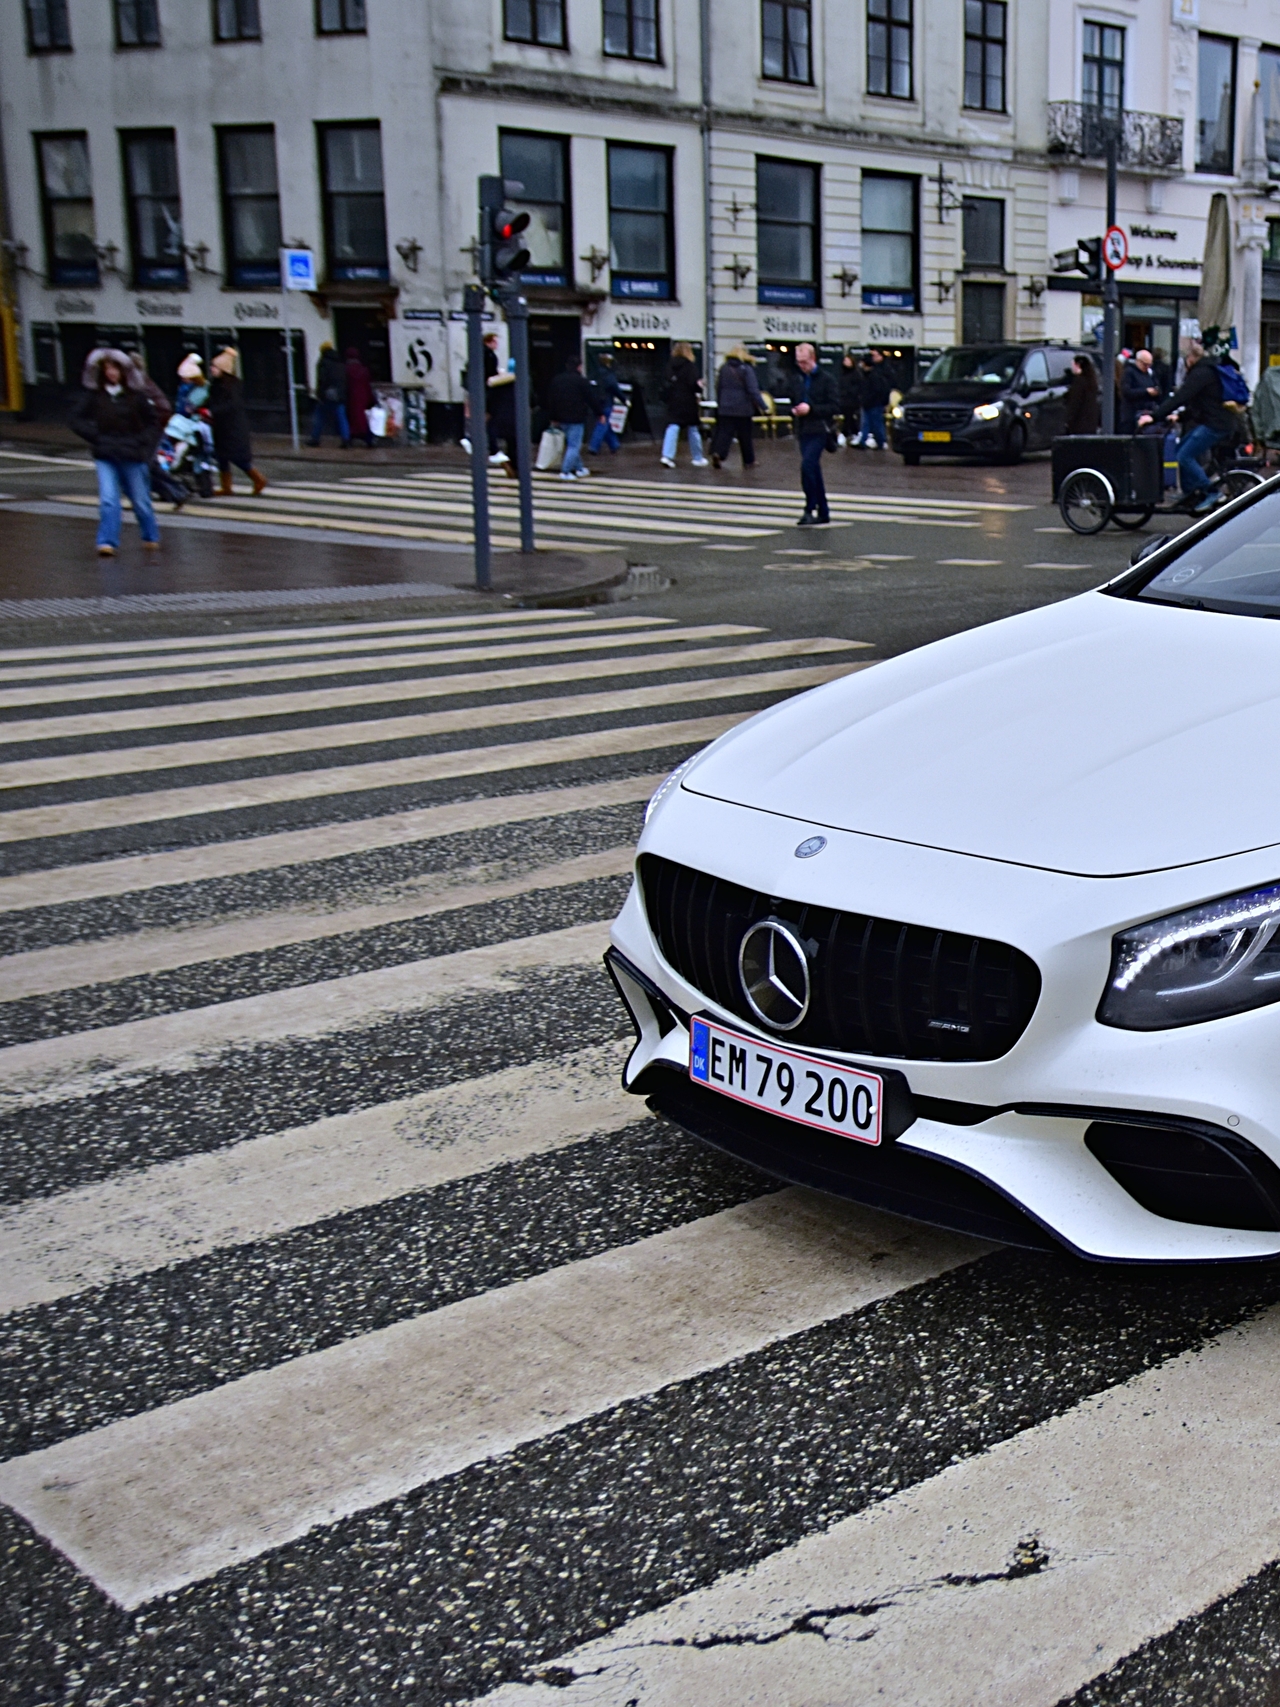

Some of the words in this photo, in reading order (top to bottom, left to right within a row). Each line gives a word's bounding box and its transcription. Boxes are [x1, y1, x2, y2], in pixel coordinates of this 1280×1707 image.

[1129, 224, 1177, 240] Welcome
[1157, 255, 1203, 270] Souvenir
[614, 312, 670, 332] Hviids
[869, 323, 914, 340] Hviids
[941, 1023, 970, 1033] AMG
[694, 1055, 705, 1072] DK
[710, 1036, 746, 1091] EM
[756, 1053, 795, 1107] 79
[804, 1071, 874, 1130] 200
